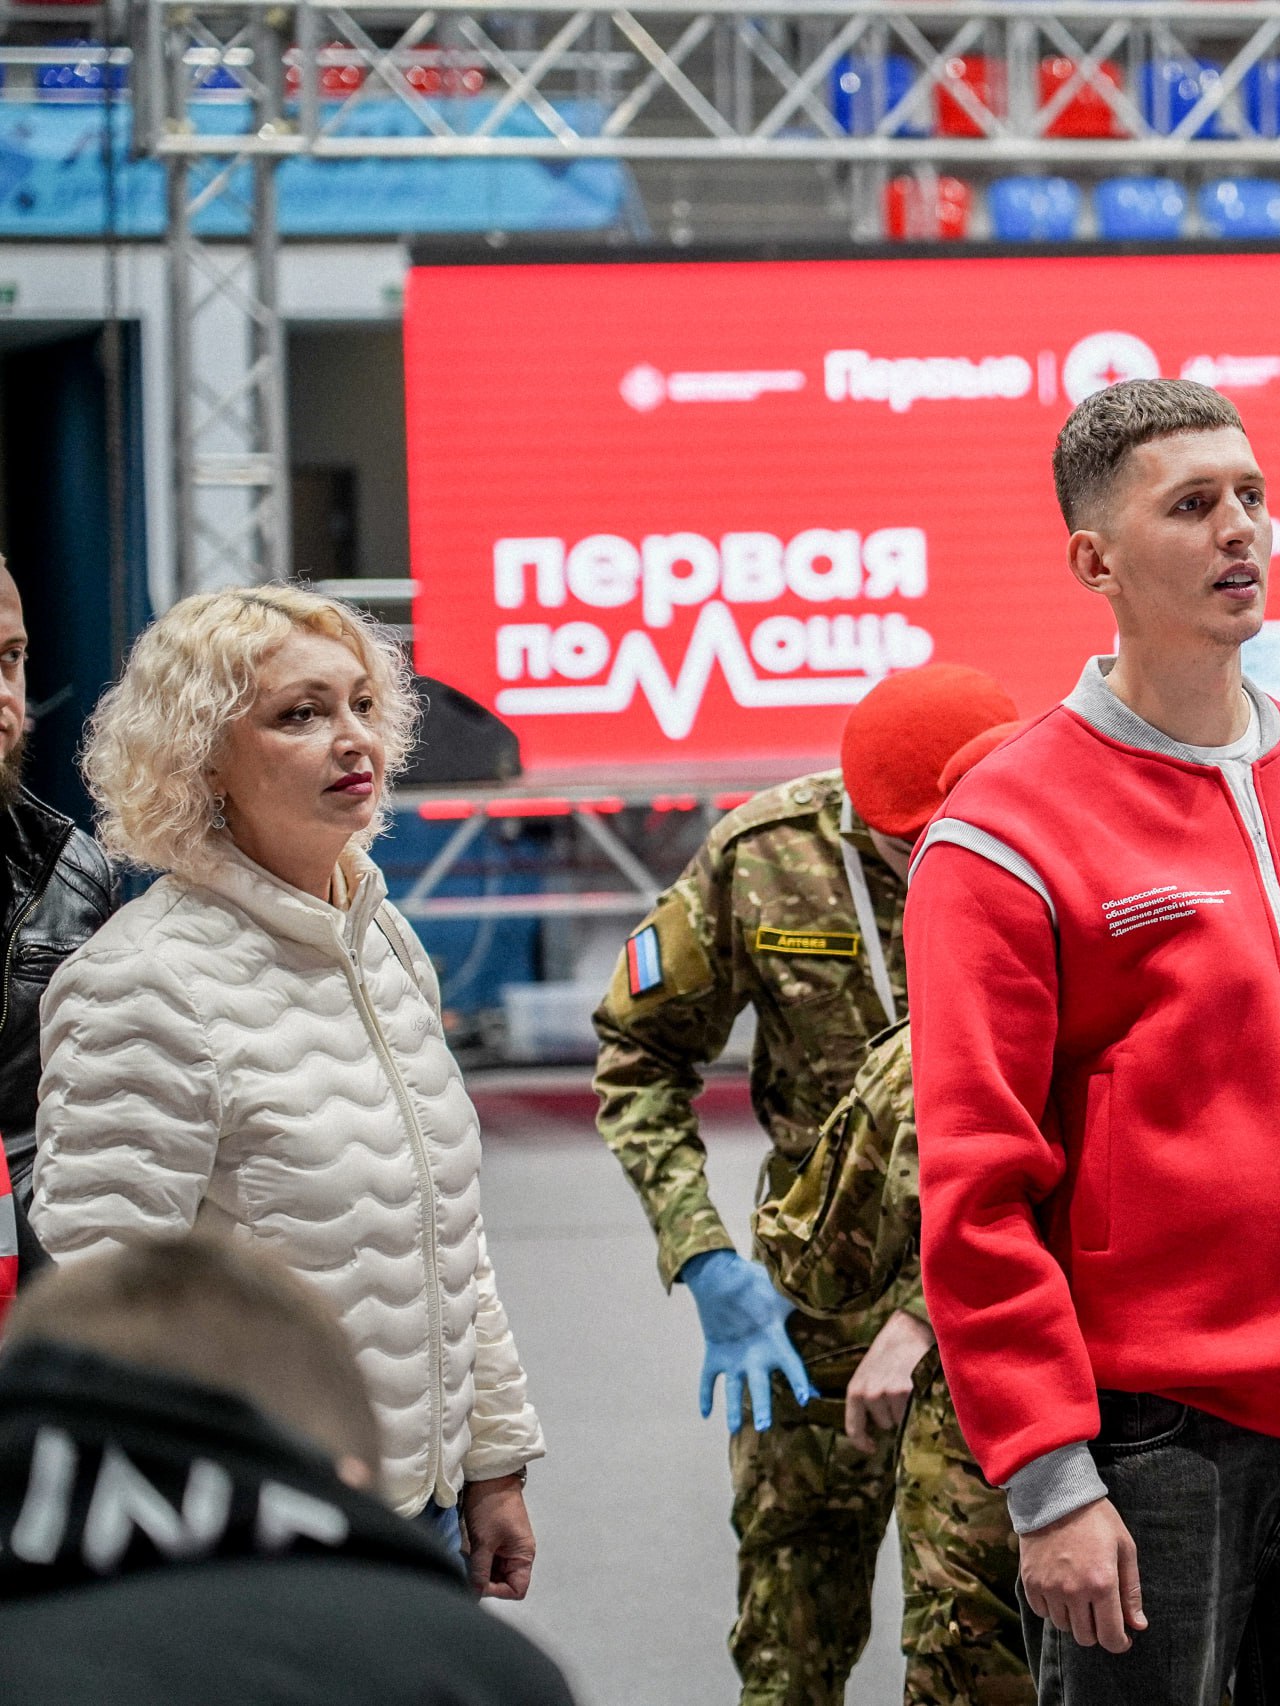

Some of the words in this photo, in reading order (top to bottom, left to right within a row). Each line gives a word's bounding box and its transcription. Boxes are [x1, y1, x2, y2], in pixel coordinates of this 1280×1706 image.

[824, 349, 1032, 412] Первые
[495, 528, 926, 627] первая
[1109, 909, 1153, 930] движение
[1153, 903, 1179, 916] детей
[777, 936, 828, 949] Аптека
